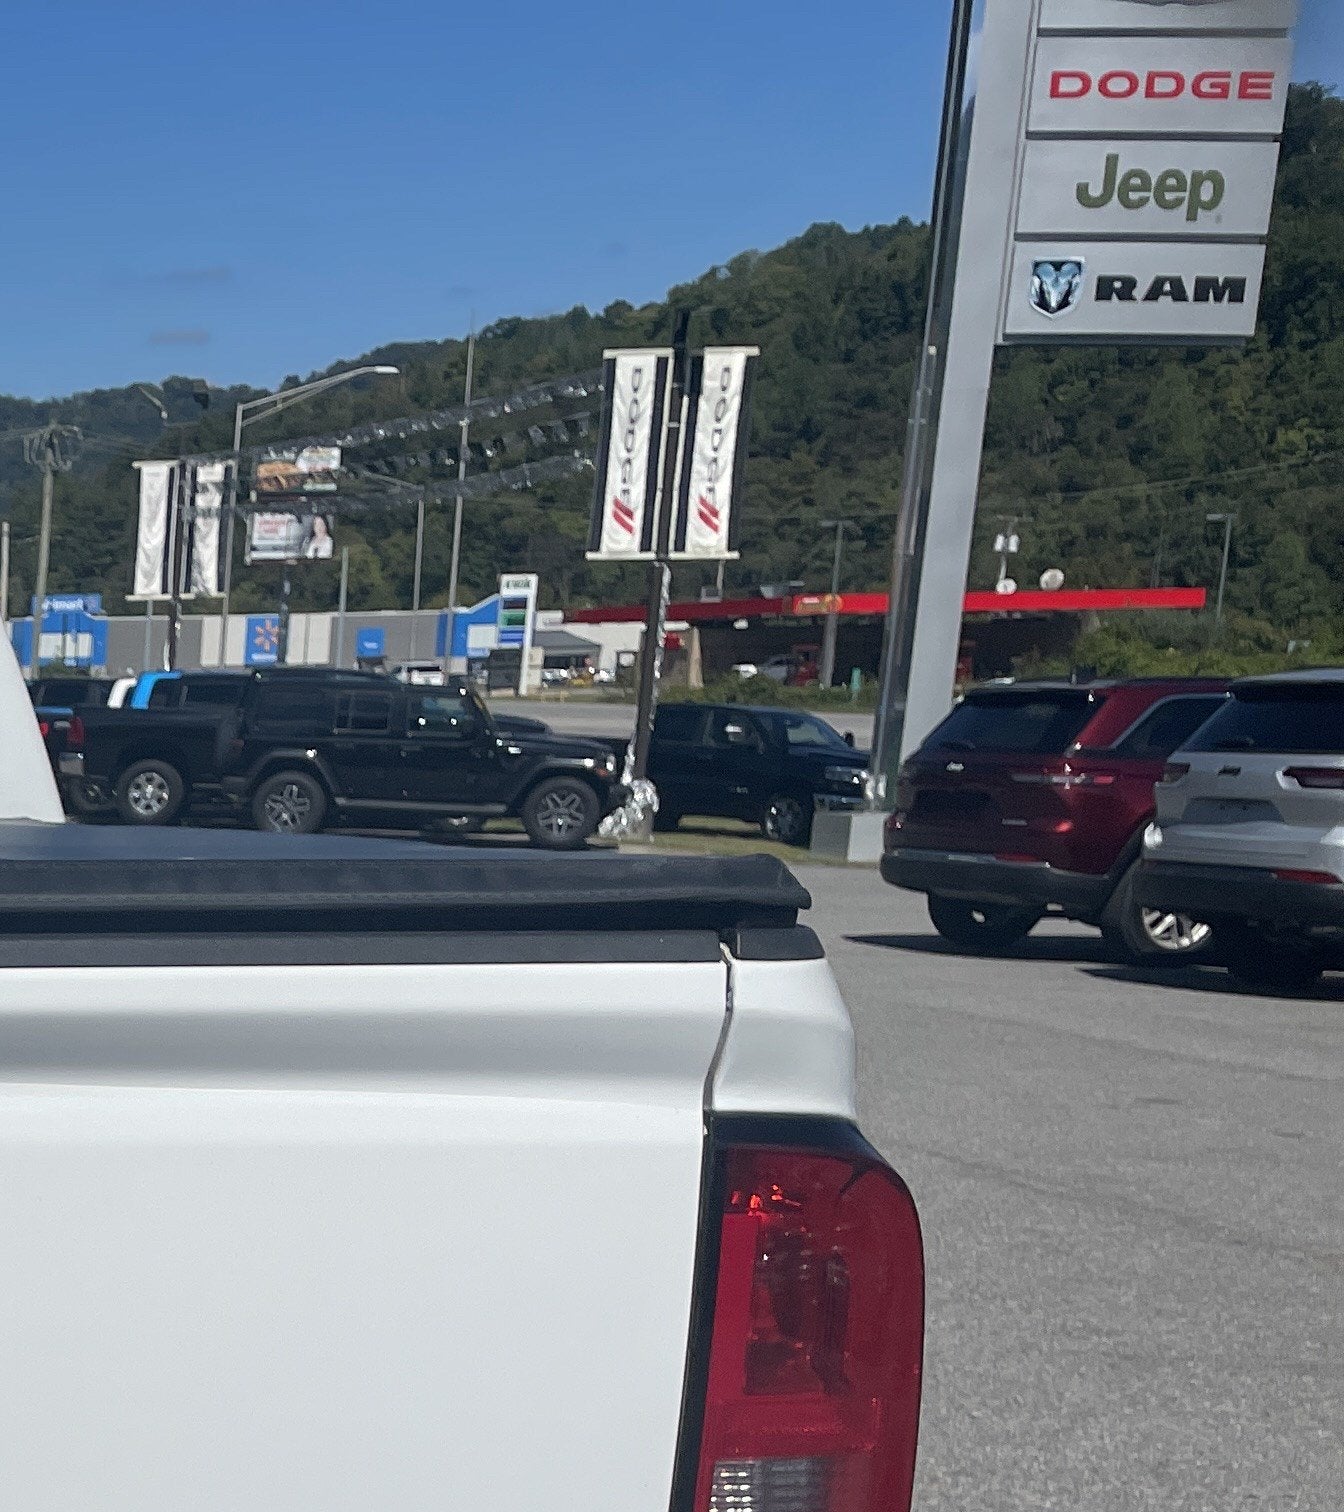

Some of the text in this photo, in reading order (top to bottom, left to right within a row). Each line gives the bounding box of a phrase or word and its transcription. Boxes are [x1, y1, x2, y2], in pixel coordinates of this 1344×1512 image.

[1049, 70, 1276, 100] DODGE
[1075, 152, 1225, 222] Jeep
[1094, 274, 1247, 304] RAM
